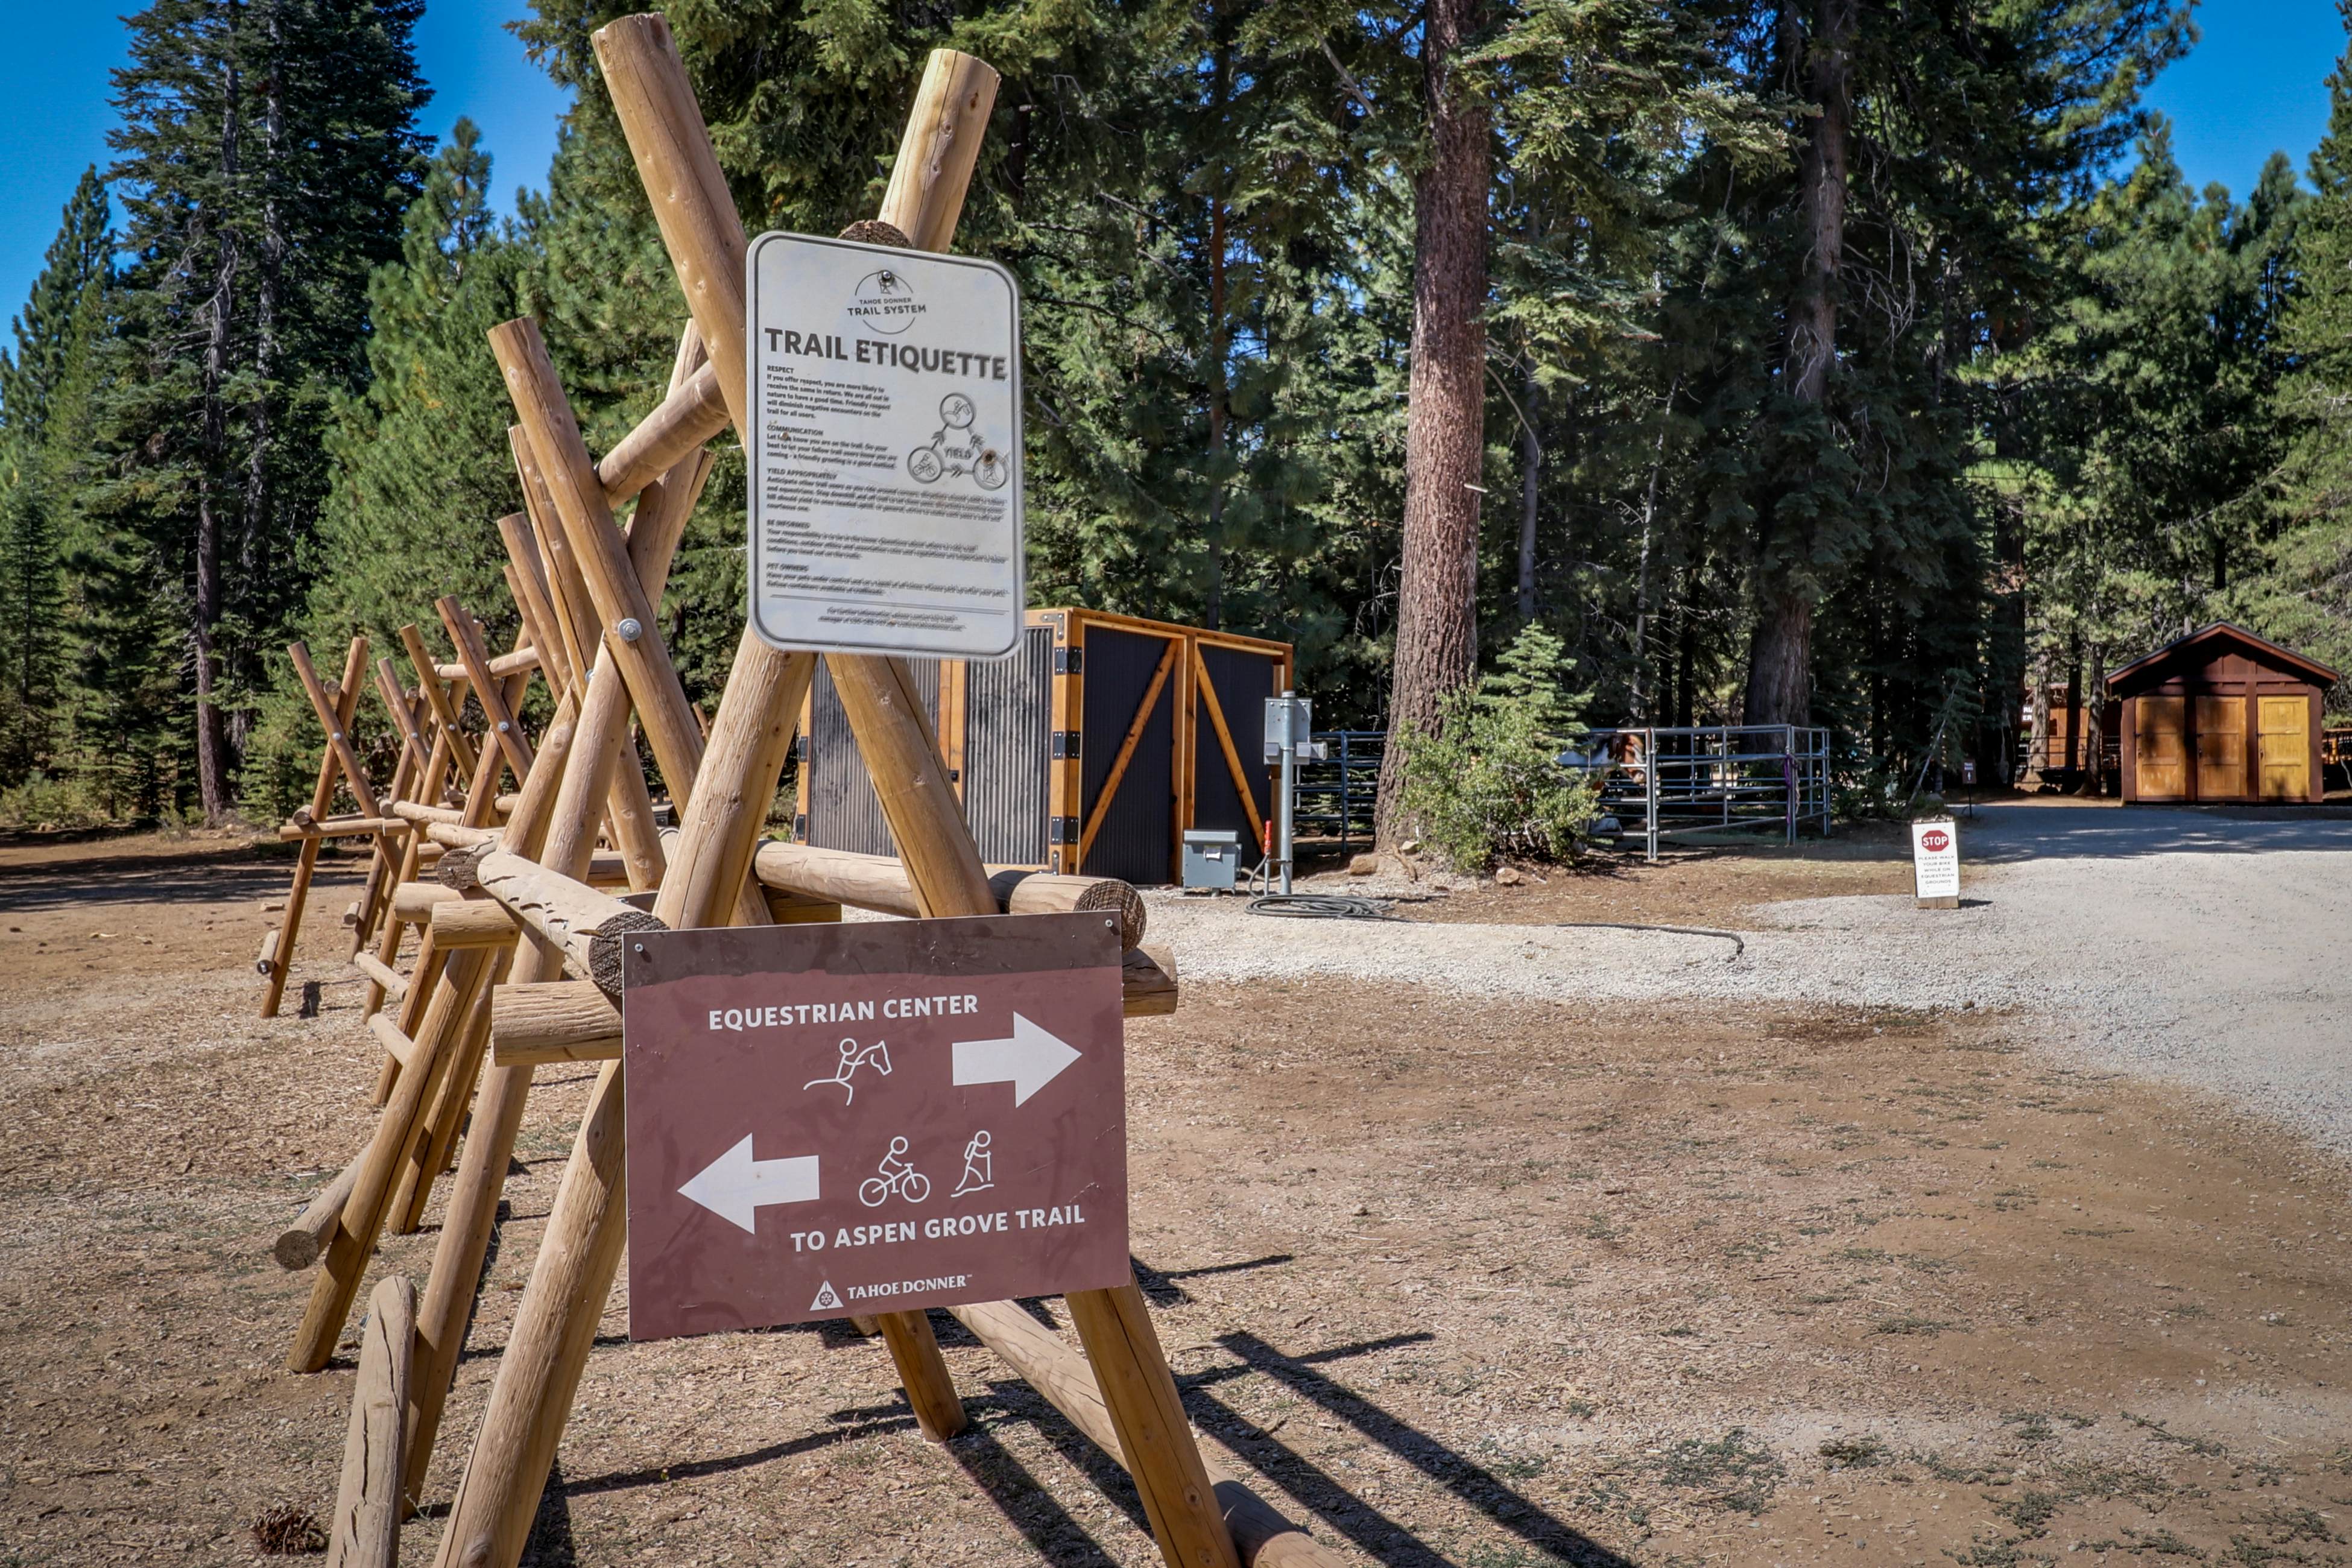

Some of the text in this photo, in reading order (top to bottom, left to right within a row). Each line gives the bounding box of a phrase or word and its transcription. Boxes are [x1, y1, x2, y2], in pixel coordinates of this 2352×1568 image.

[847, 305, 926, 316] TRAIL SYSTEM
[765, 327, 1008, 382] TRAIL ETIQUETTE
[767, 365, 794, 374] RESPECT
[800, 378, 823, 387] respect,
[862, 384, 877, 393] likely
[805, 403, 829, 413] negative
[846, 400, 868, 408] Friendly
[767, 425, 823, 436] COMMUNICATION
[1923, 836, 1948, 847] STOP
[709, 994, 978, 1032] EQUESTRIAN CENTER
[791, 1204, 1085, 1252] TO ASPEN GROVE TRAIL
[847, 1282, 900, 1300] TAHOE
